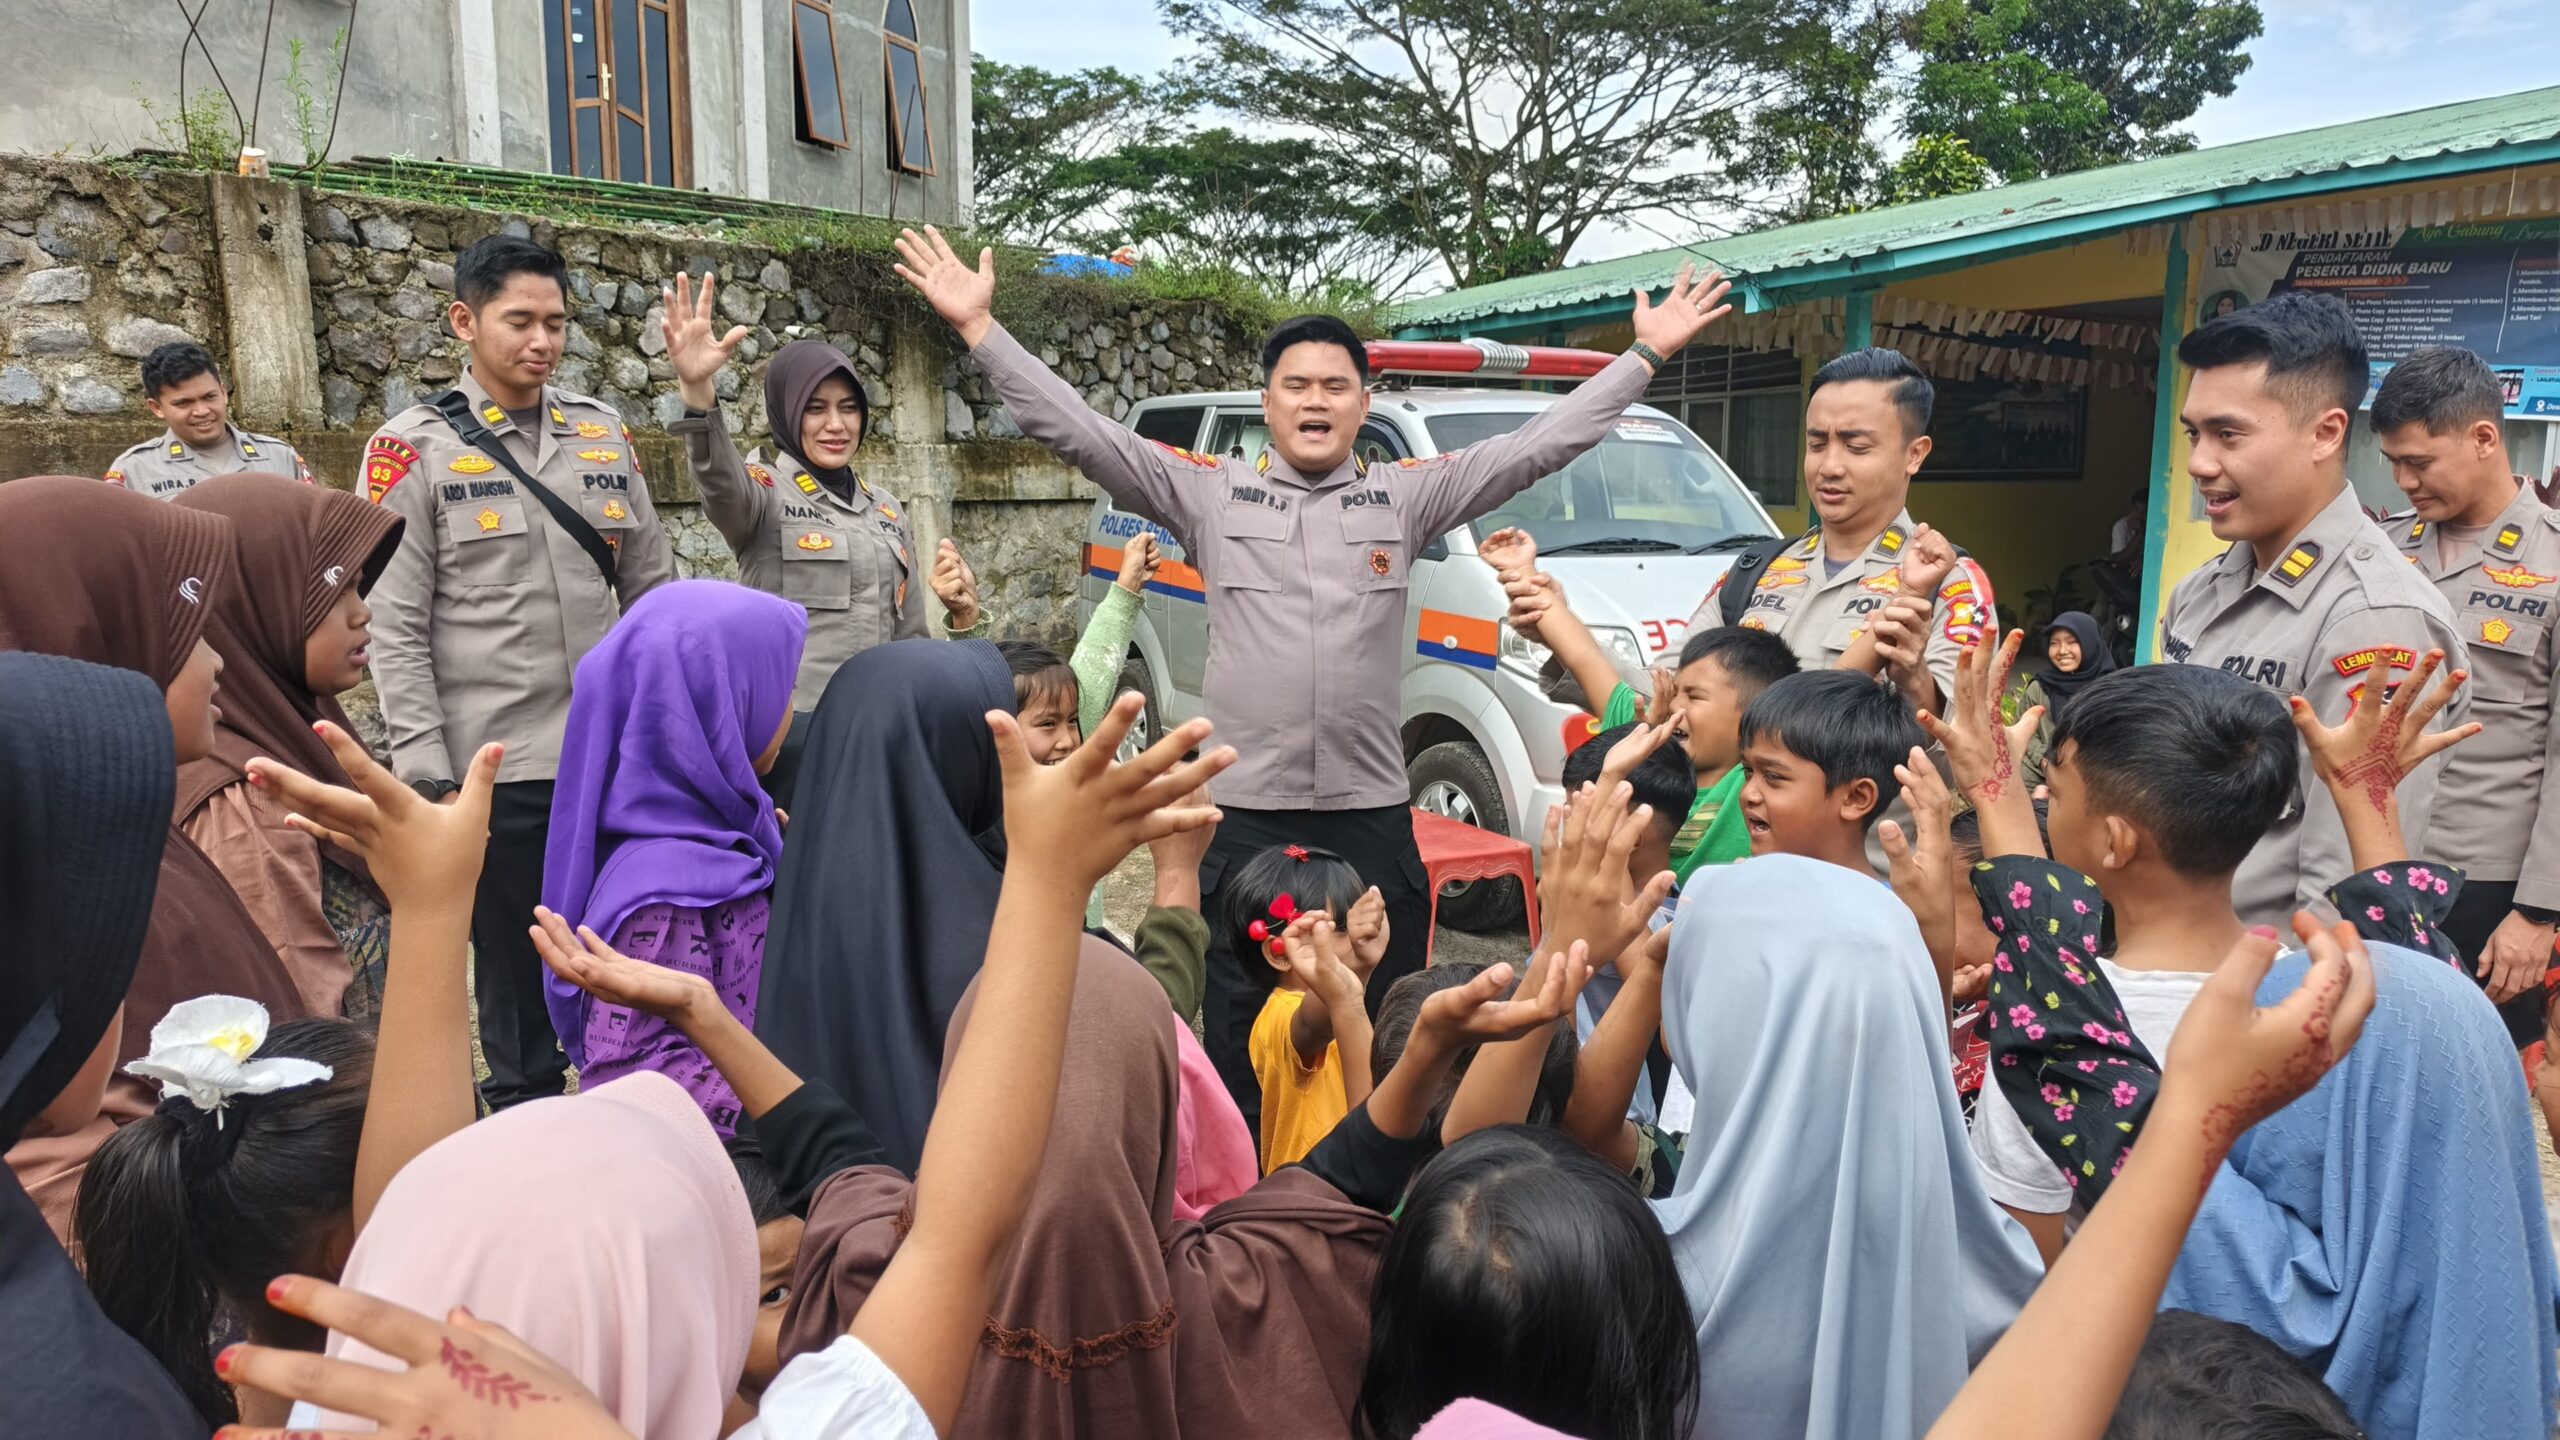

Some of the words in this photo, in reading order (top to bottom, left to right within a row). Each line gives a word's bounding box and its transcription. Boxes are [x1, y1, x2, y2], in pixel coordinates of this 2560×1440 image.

[2303, 251, 2391, 264] PENDAFTARAN
[2296, 266, 2357, 277] PESERTA
[2361, 263, 2402, 276] DIDIK
[2407, 261, 2452, 274] BARU
[374, 439, 411, 459] STIK
[371, 465, 392, 482] 83
[583, 473, 628, 491] POLRI
[1231, 485, 1267, 504] TOMMY
[1340, 489, 1391, 510] POLRI
[1099, 514, 1143, 538] POLRES
[2468, 591, 2548, 618] POLRI
[2221, 655, 2287, 688] POLRI
